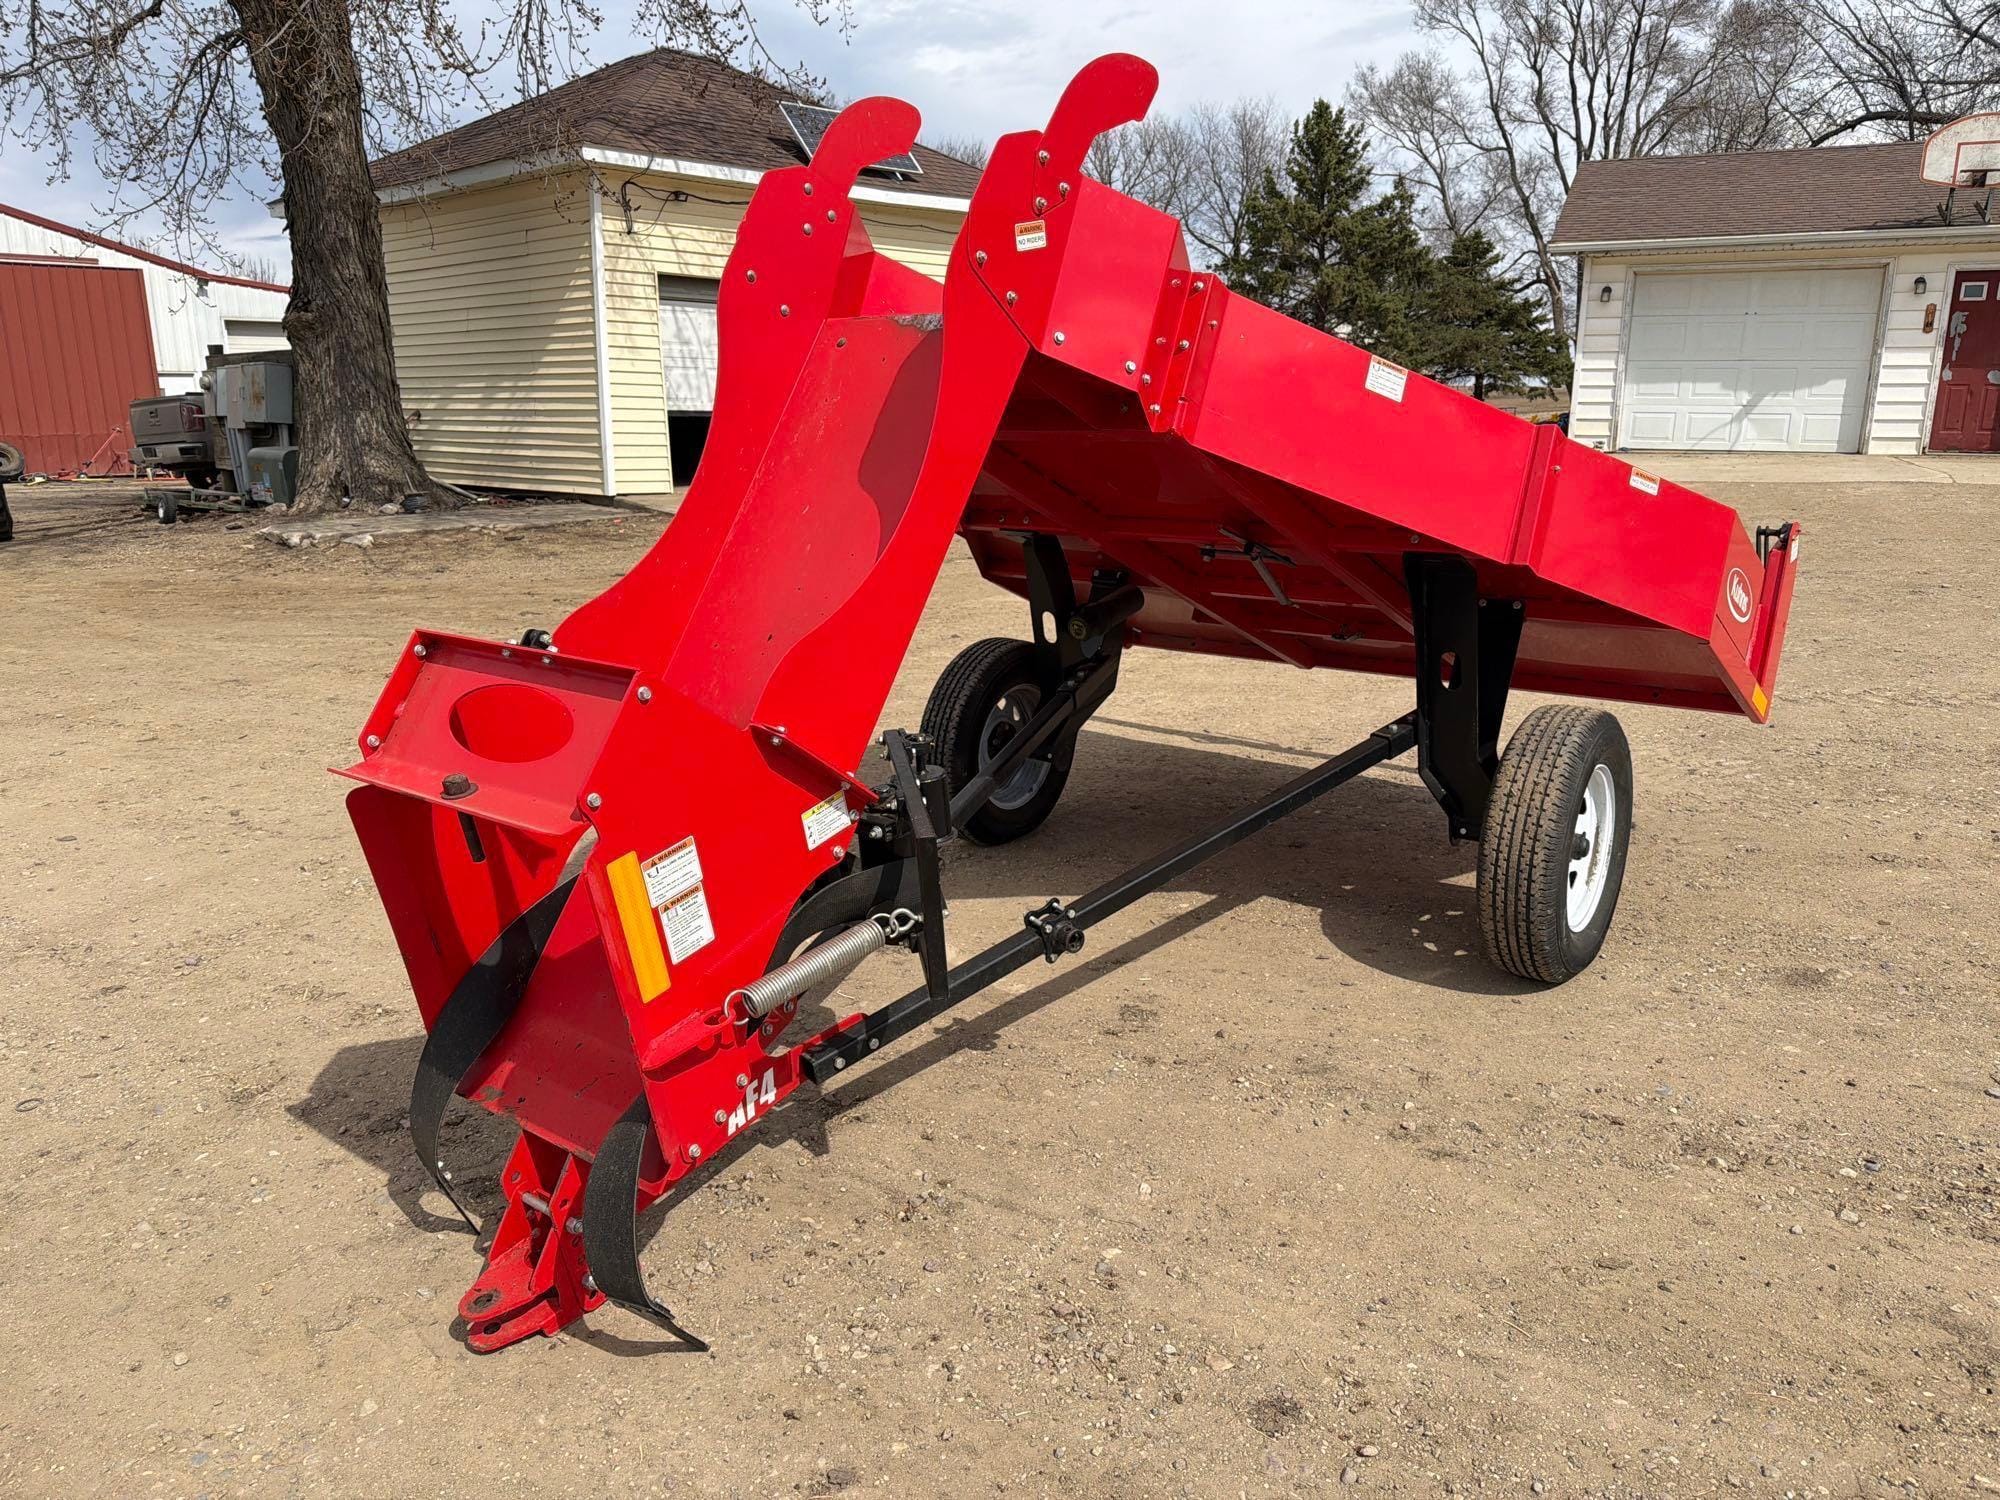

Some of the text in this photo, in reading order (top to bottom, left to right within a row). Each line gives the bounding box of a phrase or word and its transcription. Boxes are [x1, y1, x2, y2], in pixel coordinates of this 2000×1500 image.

[1023, 224, 1042, 232] WARNING
[1027, 235, 1044, 243] RIDERS
[658, 842, 687, 861] WARNING
[670, 886, 699, 906] WARNING
